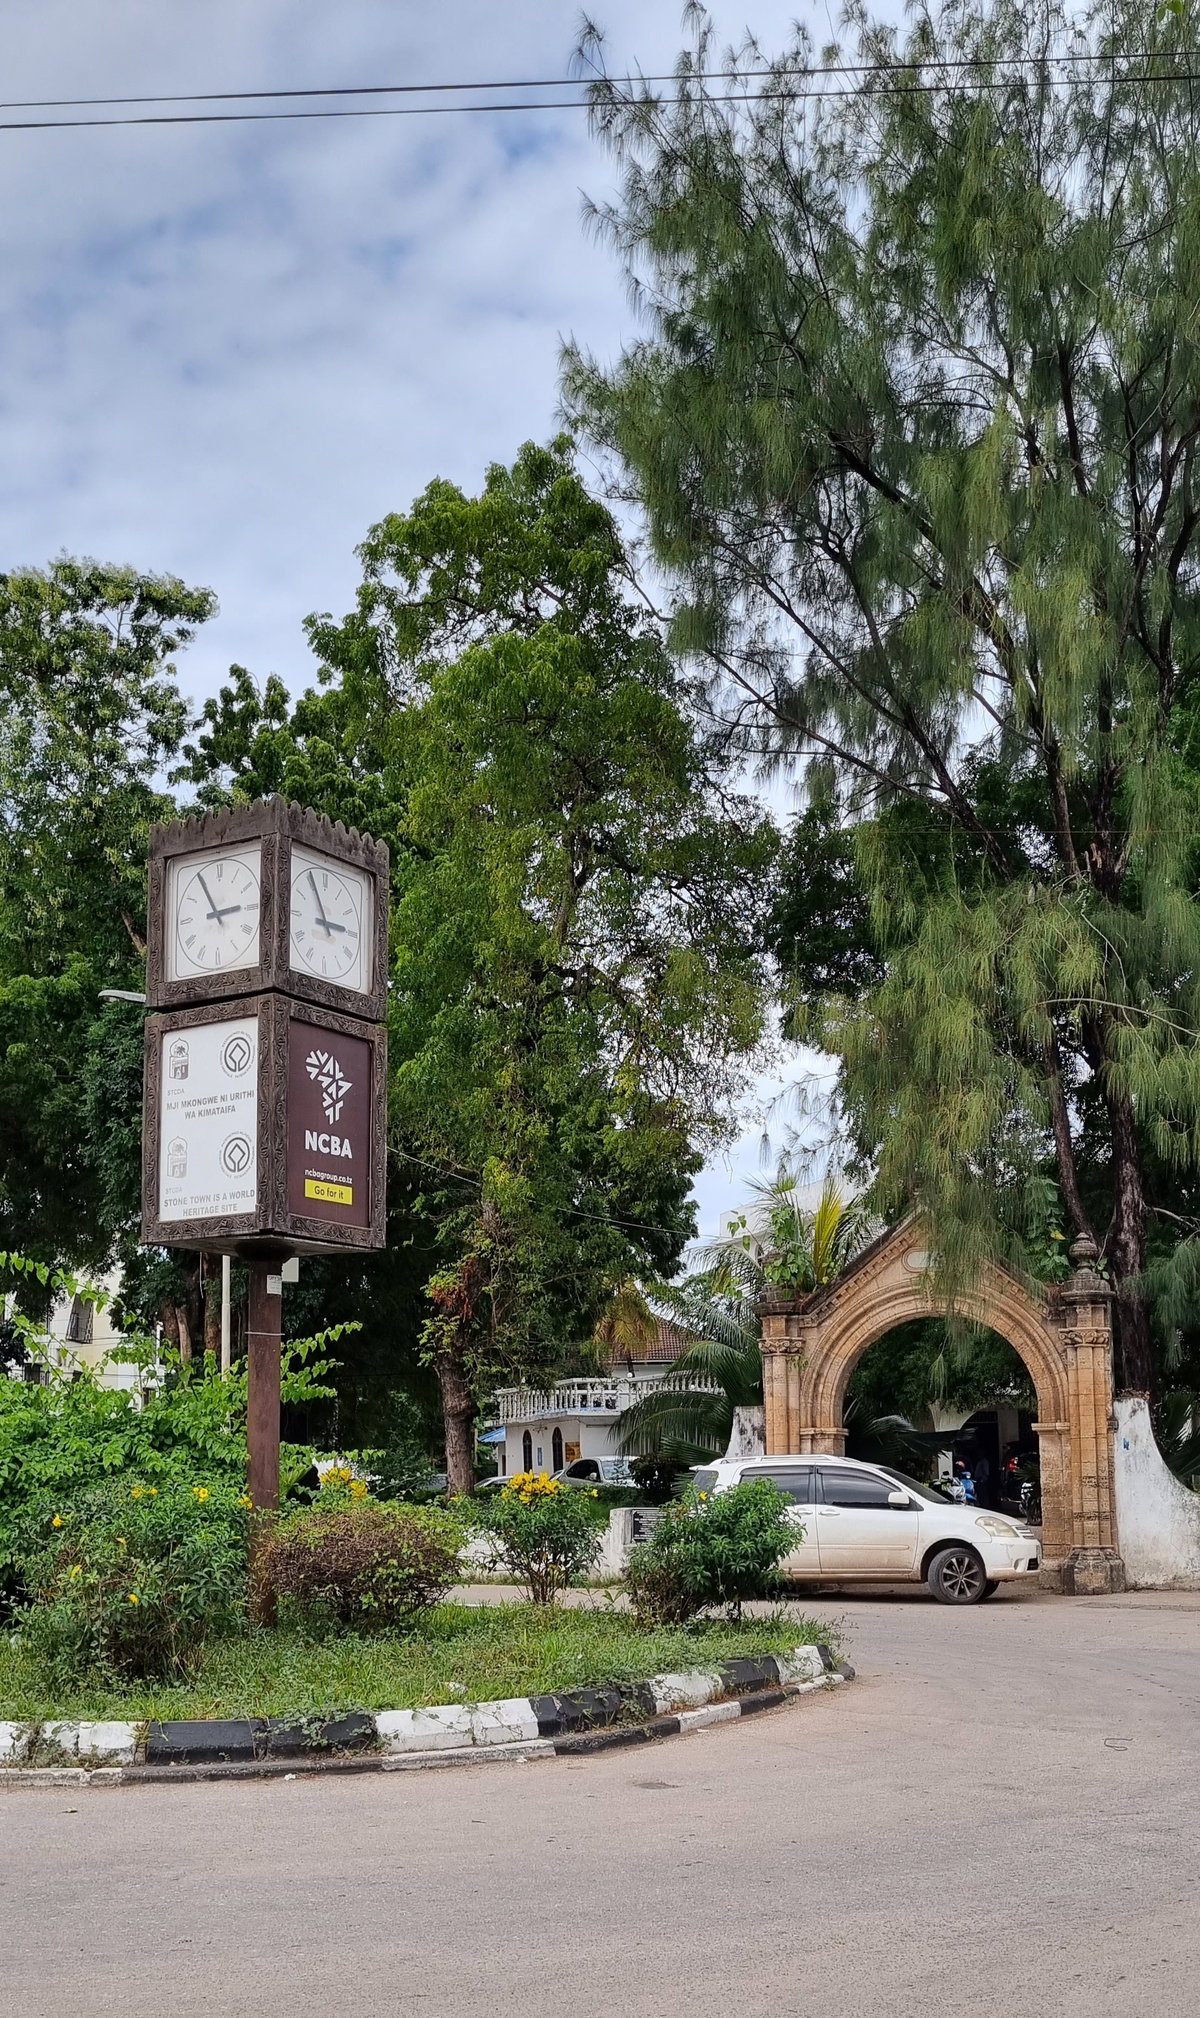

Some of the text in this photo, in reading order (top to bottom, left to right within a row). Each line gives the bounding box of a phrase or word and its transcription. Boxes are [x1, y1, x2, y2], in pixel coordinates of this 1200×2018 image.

[166, 1089, 255, 1111] MJI MKONGWE NI URITHI
[184, 1105, 236, 1120] WA KIMATAIFA
[305, 1129, 353, 1159] NCBA
[304, 1168, 353, 1184] ncbagroup.co.tz
[164, 1189, 255, 1207] STONE TOWN IS A WORLD
[314, 1185, 344, 1199] Go for it
[183, 1203, 238, 1217] HERITAGE SITE
